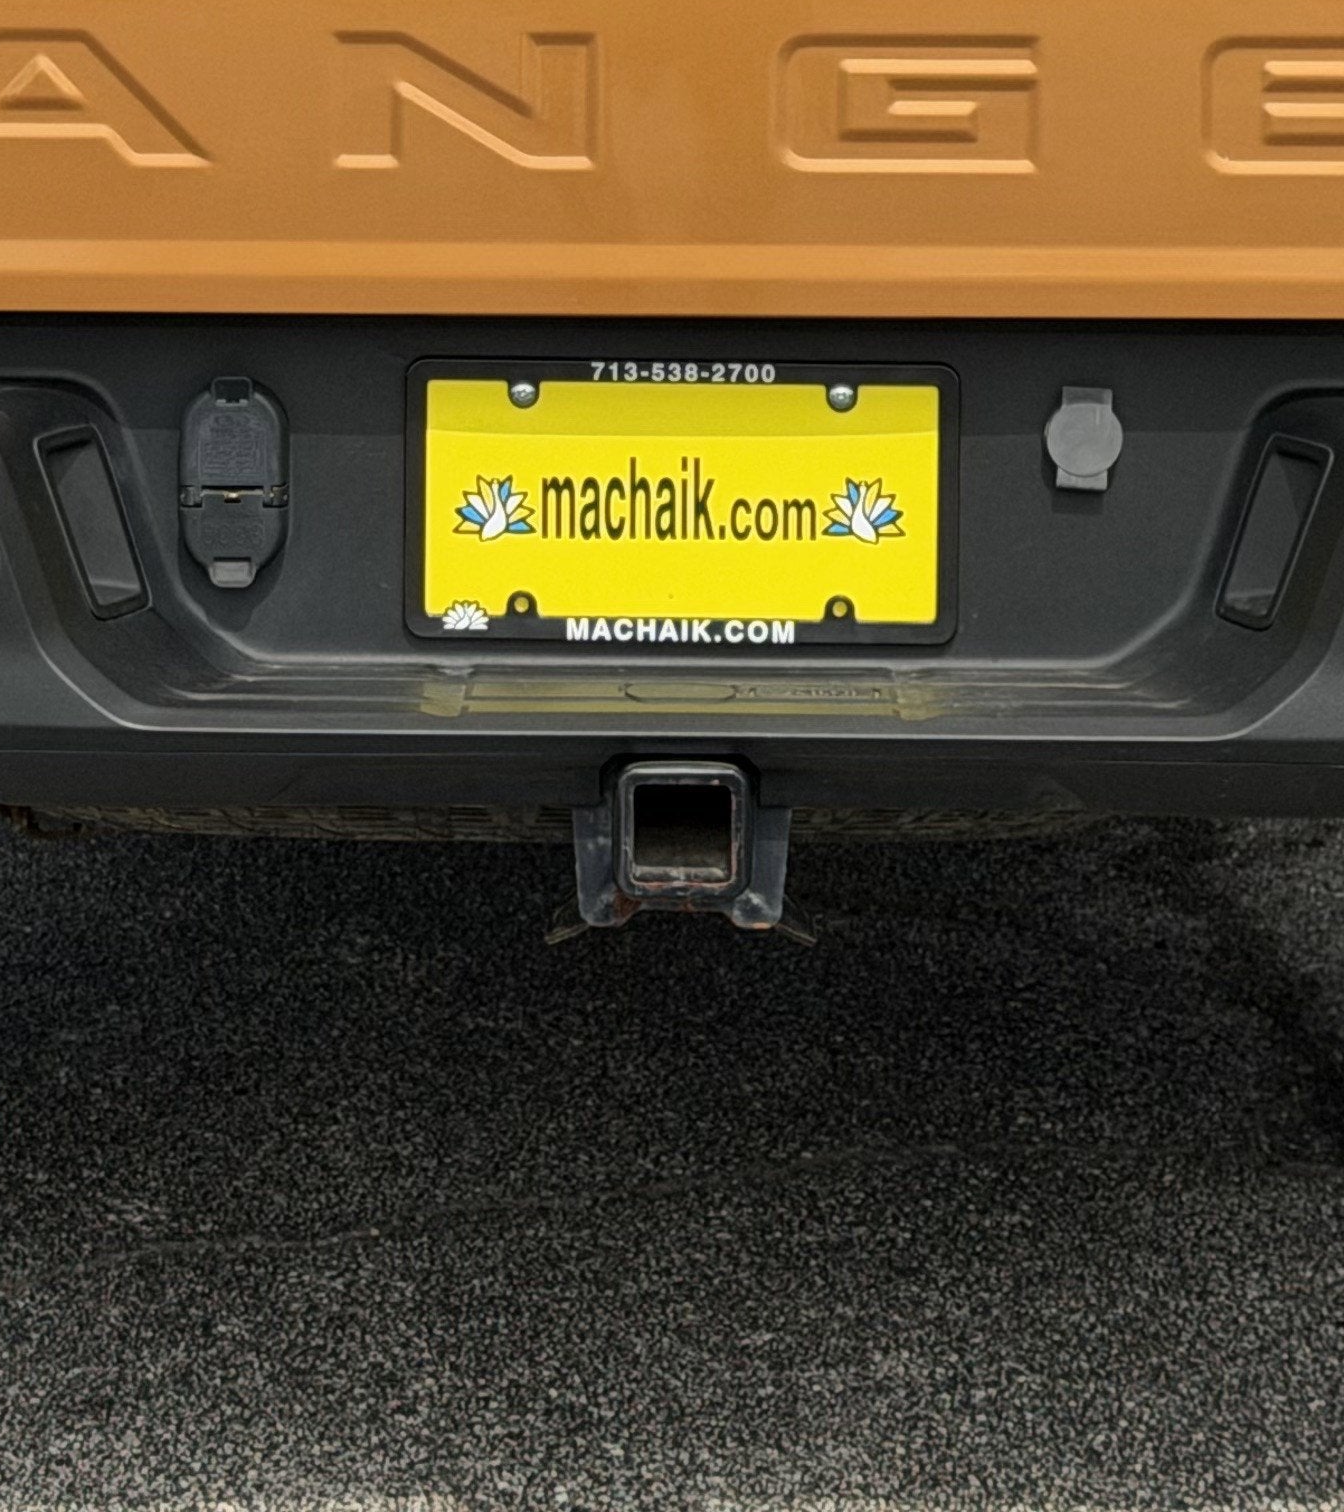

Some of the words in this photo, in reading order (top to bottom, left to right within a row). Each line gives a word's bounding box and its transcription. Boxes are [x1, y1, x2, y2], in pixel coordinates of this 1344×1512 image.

[590, 361, 777, 384] 713-538-2700
[540, 455, 818, 542] machaik.com
[565, 616, 796, 645] MACHAIK.COM
